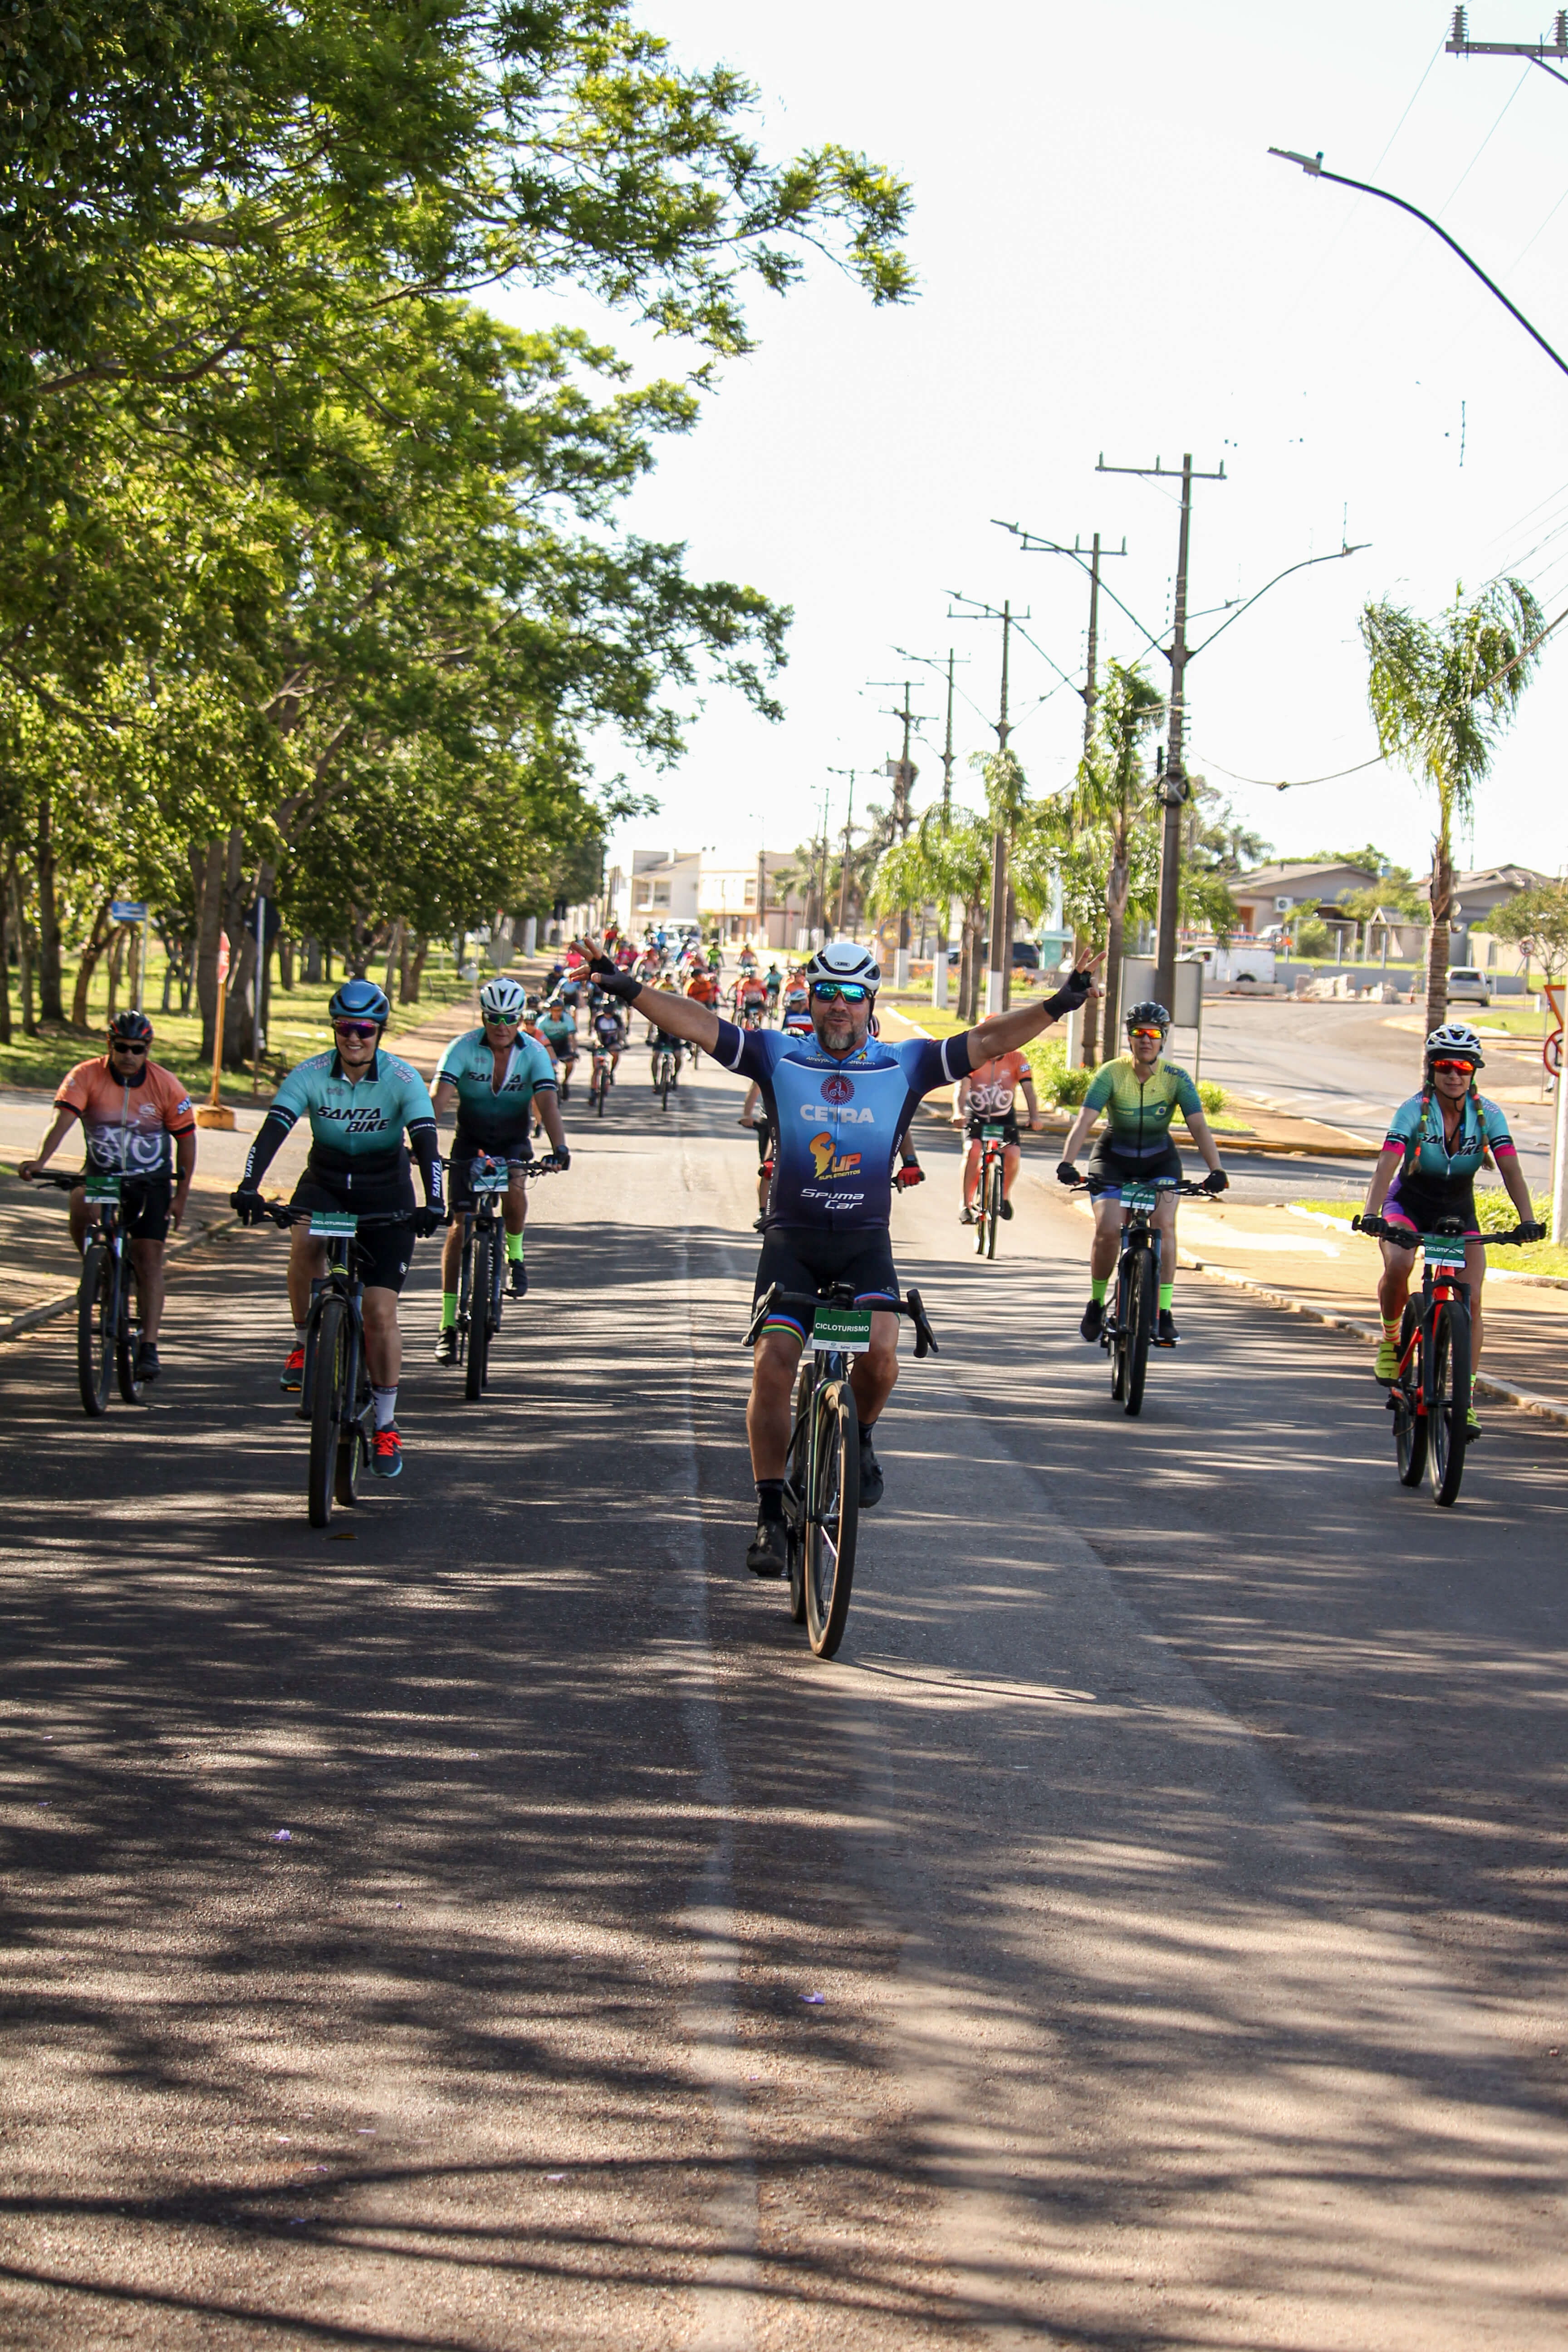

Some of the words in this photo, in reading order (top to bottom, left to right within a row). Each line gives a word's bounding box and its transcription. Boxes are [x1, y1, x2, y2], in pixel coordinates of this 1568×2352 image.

[317, 1106, 381, 1120] SANTA
[800, 1104, 875, 1124] CETRA
[345, 1118, 391, 1133] BIKE
[245, 1146, 257, 1178] SANTA
[831, 1152, 862, 1173] UP
[432, 1159, 443, 1198] SANTA
[815, 1323, 870, 1332] CICLOTURISMO
